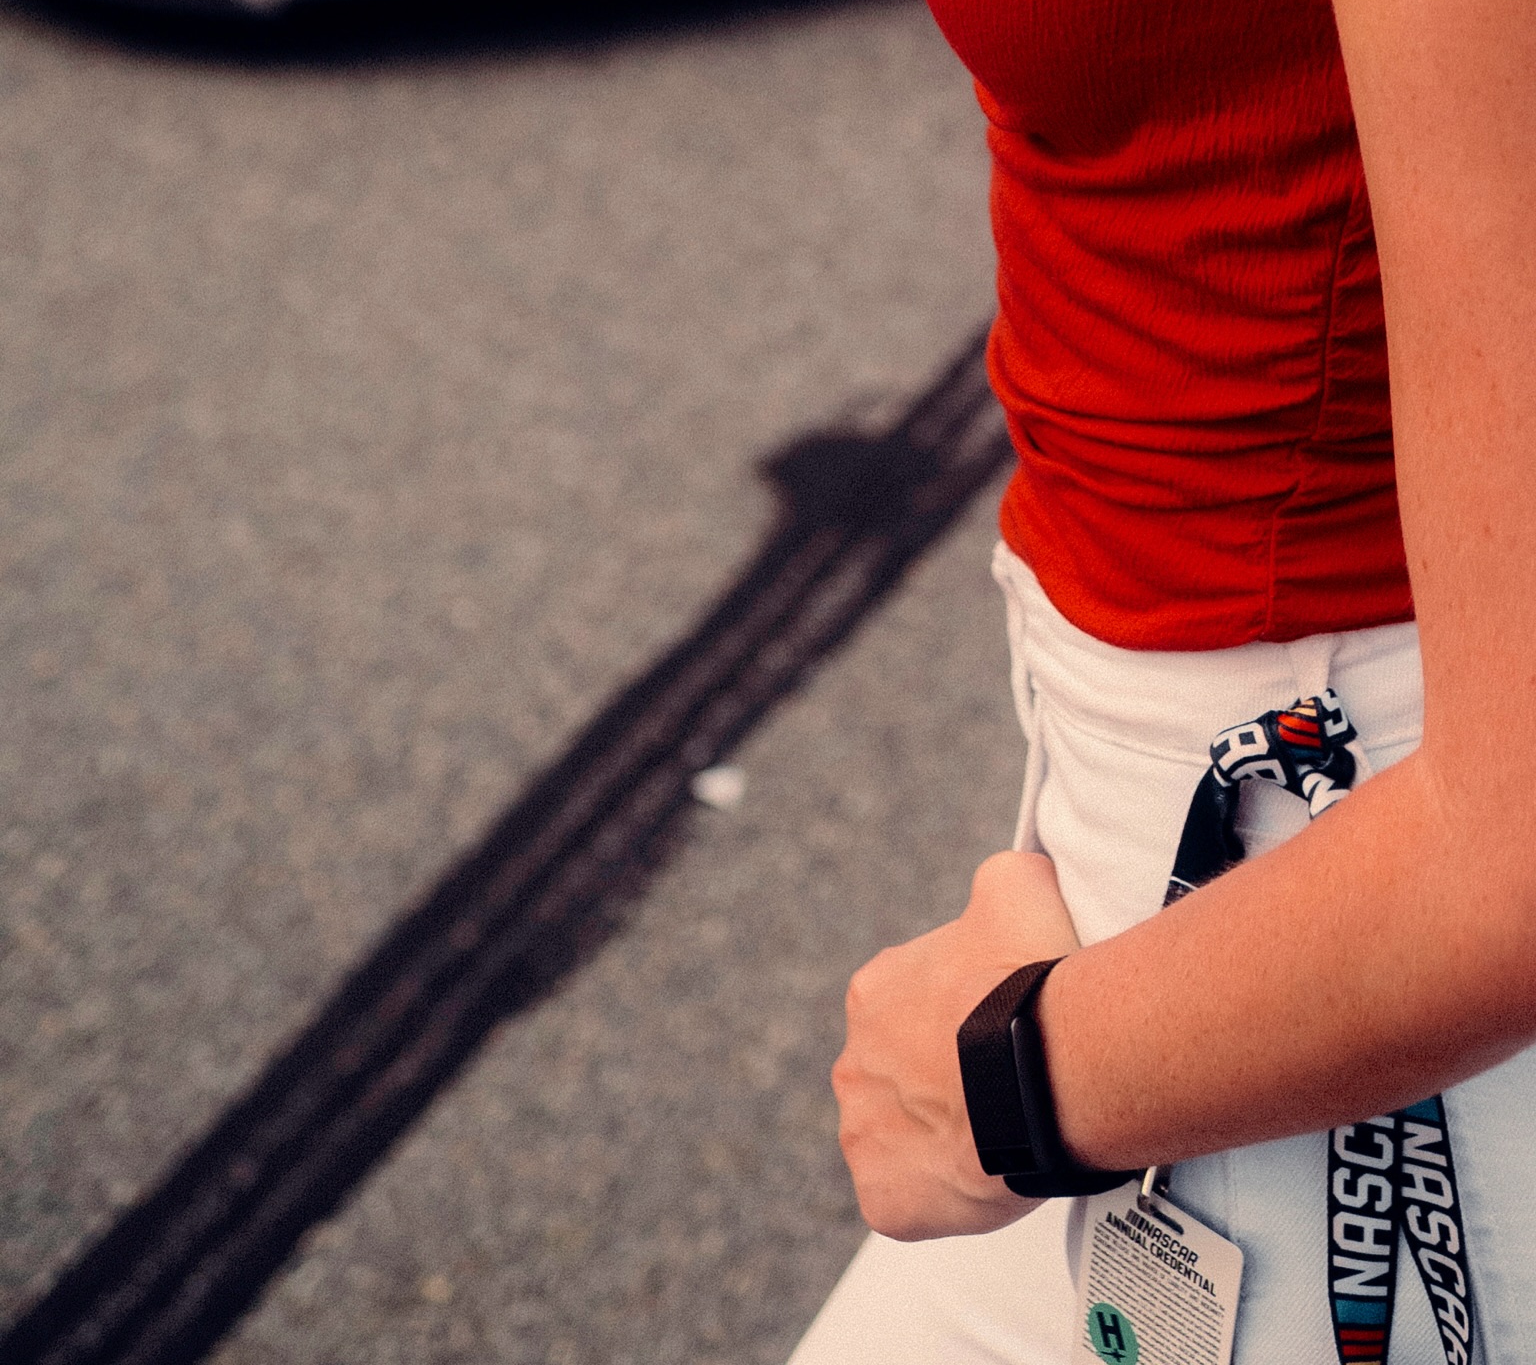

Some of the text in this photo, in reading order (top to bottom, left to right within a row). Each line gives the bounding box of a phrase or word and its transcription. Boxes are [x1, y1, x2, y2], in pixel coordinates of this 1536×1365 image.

[1106, 1211, 1217, 1298] ANNUAL CREDENTIAL
[1142, 1218, 1200, 1267] NASCAR
